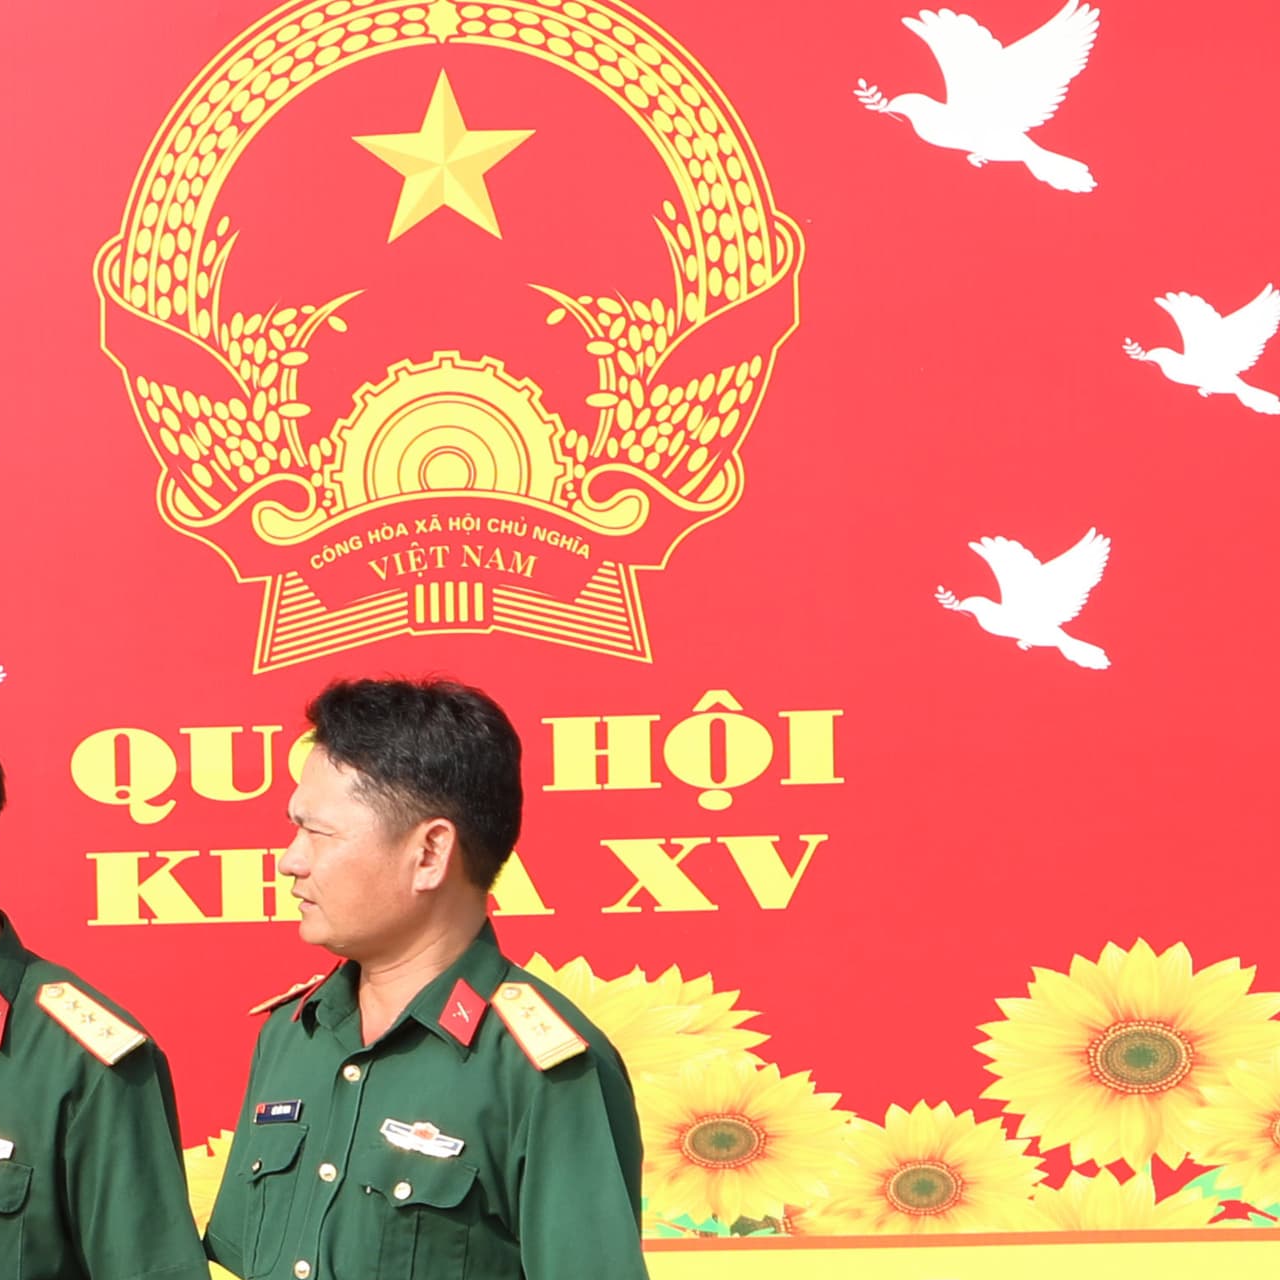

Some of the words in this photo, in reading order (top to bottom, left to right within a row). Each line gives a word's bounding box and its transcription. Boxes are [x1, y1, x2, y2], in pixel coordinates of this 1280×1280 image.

[368, 522, 409, 545] HÒA
[415, 514, 442, 534] XÃ
[449, 513, 481, 535] HỘI
[487, 516, 527, 537] CHỦ
[533, 526, 590, 559] NGHĨA
[368, 542, 450, 581] VIỆT
[461, 544, 538, 578] NAM
[541, 689, 844, 811] HỘI
[86, 848, 555, 926] KHA
[600, 834, 829, 914] XV
